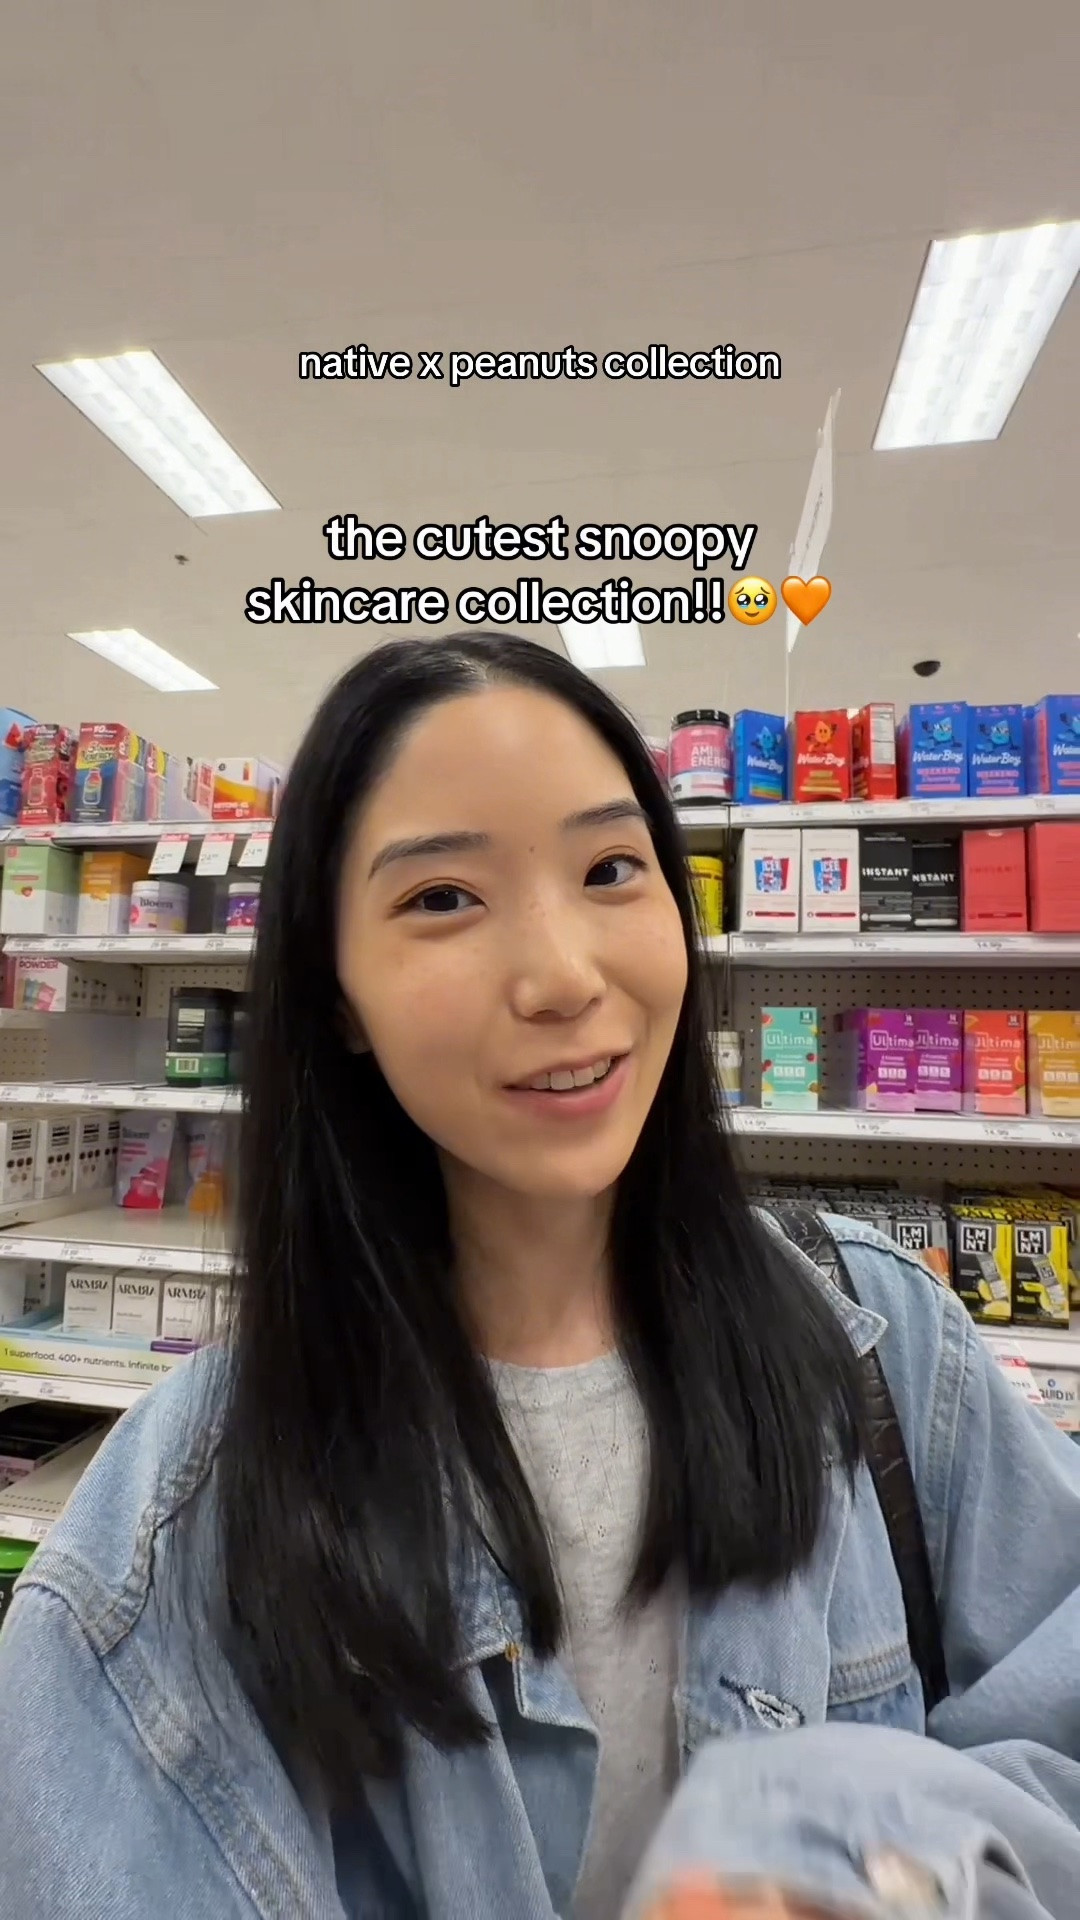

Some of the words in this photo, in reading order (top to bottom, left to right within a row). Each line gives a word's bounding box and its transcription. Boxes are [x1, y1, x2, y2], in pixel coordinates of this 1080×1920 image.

[862, 867, 909, 876] INSTANT
[912, 873, 955, 882] NSTANT
[19, 960, 59, 969] POWDER
[766, 1033, 814, 1046] Ultima
[873, 1035, 914, 1047] Ultima
[965, 1228, 986, 1240] LM
[1020, 1231, 1041, 1242] LM
[966, 1240, 986, 1251] NT
[1020, 1244, 1041, 1254] NT
[10, 1349, 56, 1361] superfood.
[58, 1353, 82, 1363] 400+
[83, 1357, 126, 1368] nutrients.
[128, 1360, 160, 1372] Infinite
